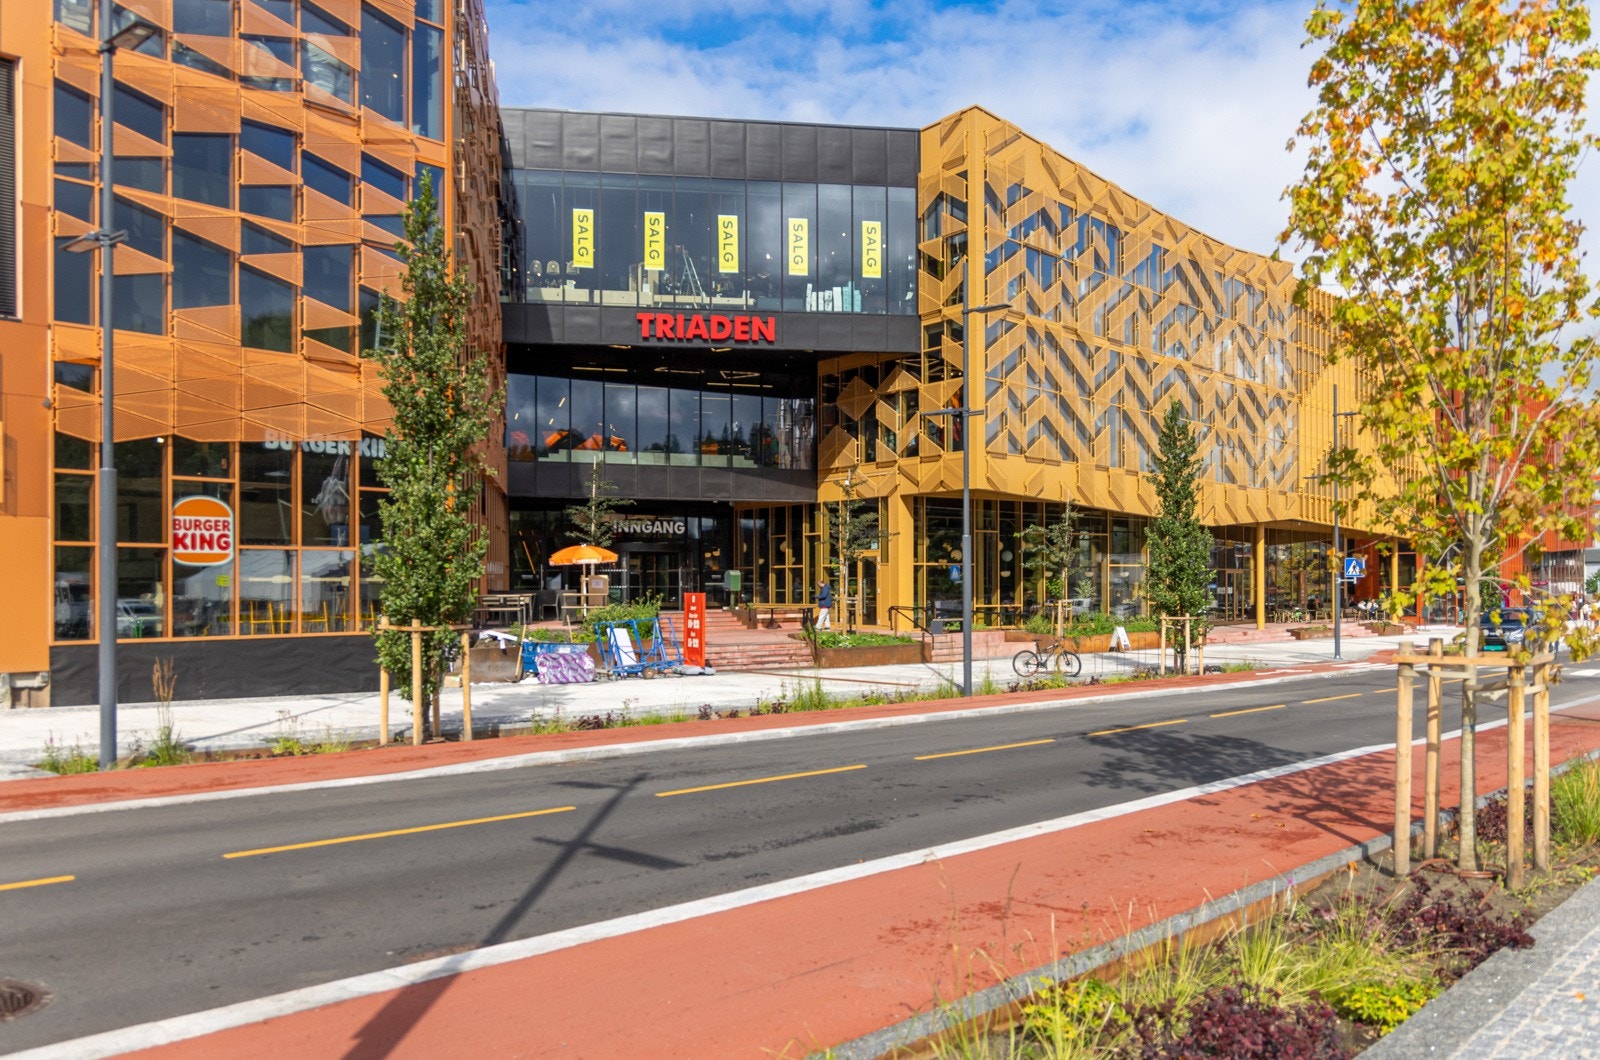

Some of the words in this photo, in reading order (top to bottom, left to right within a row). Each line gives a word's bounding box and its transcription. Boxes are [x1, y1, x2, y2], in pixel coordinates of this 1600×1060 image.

[577, 214, 589, 257] SALG
[649, 217, 660, 260] SALG
[722, 220, 734, 263] SALG
[793, 223, 804, 265] SALG
[866, 226, 877, 268] SALG
[636, 312, 776, 342] TRIADEN
[173, 518, 231, 532] BURGER
[173, 532, 231, 551] KING
